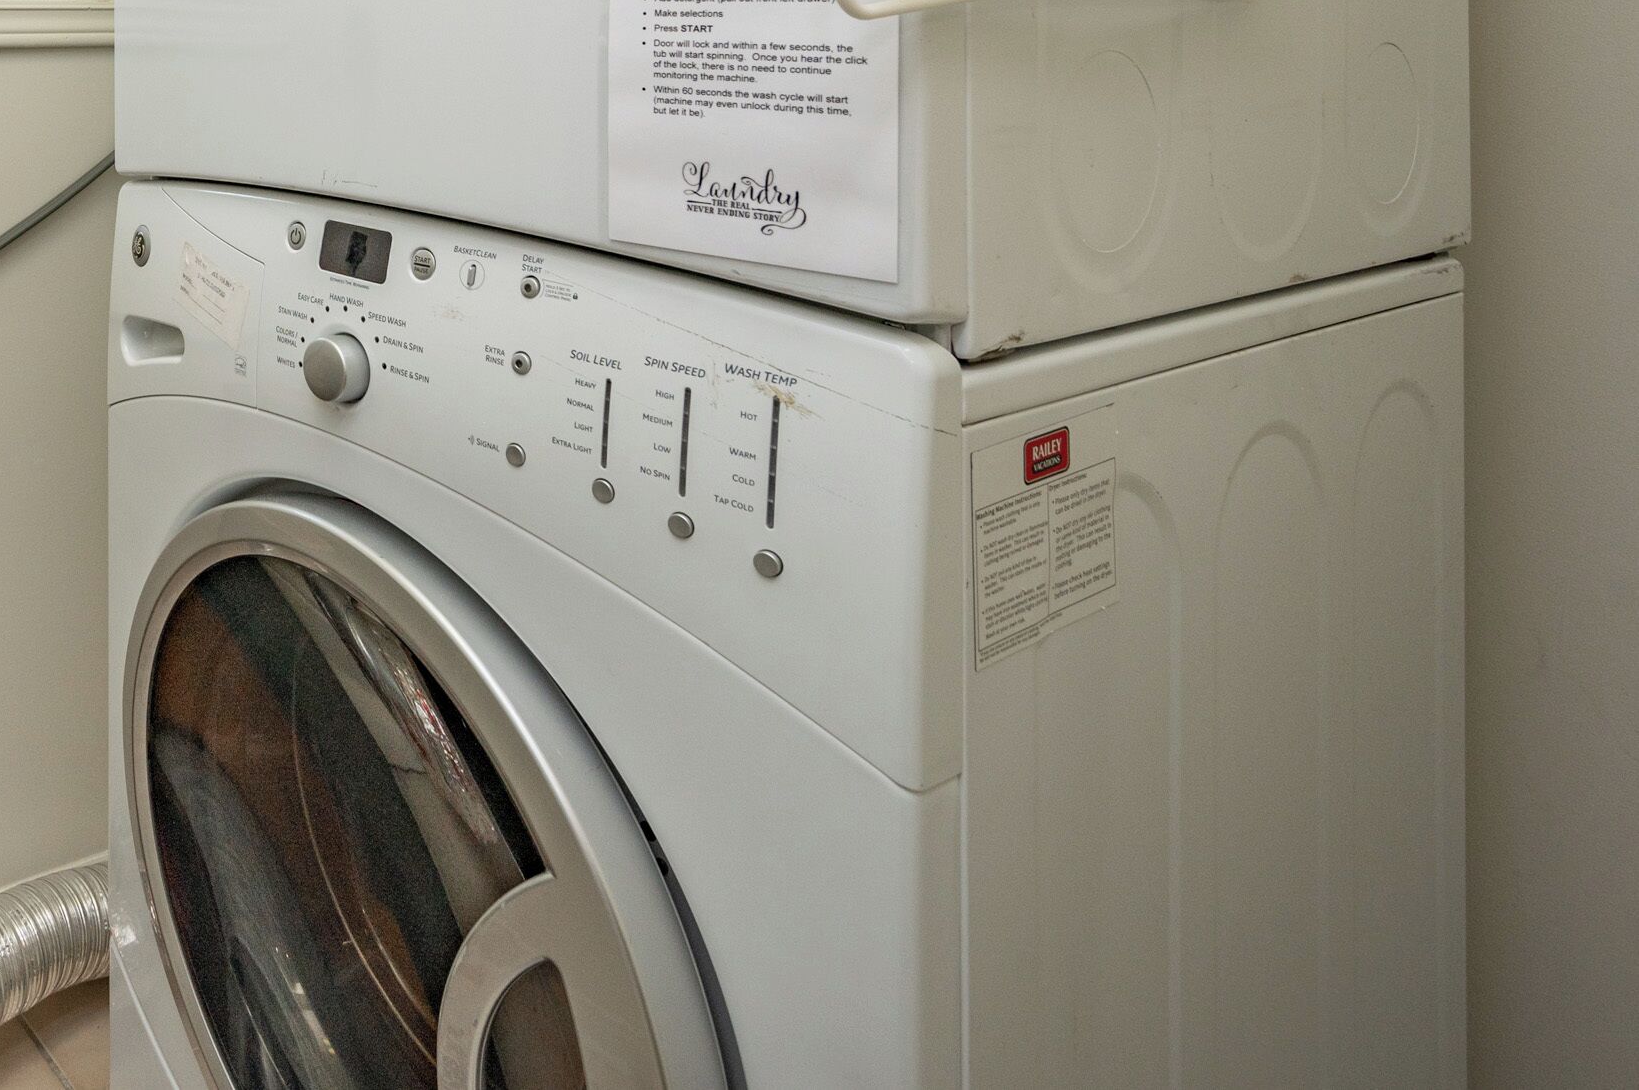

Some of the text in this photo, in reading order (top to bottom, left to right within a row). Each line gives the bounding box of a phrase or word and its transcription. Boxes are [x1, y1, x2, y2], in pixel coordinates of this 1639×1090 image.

[654, 8, 723, 18] Make selections
[653, 23, 713, 33] Press START
[682, 161, 806, 235] Laundry
[711, 198, 749, 210] THE REAL
[686, 204, 779, 222] NEVER ENDING STORY
[522, 254, 544, 264] DELAY
[522, 264, 542, 274] START
[330, 293, 364, 307] HAND WASH
[368, 312, 407, 327] SPEED WASH
[383, 336, 402, 347] DRAIN
[408, 343, 424, 353] SPIN
[485, 345, 505, 356] EXTRA
[486, 355, 504, 366] RINSE
[570, 350, 622, 370] SOIL LEVEL
[644, 356, 706, 378] SPIN SPEED
[390, 366, 408, 377] RINSE
[414, 373, 430, 383] SPIN
[725, 363, 797, 387] WASH TEMP
[575, 378, 596, 389] HEAVY
[655, 390, 674, 400] HIGH
[567, 398, 594, 411] NORMAL
[643, 414, 673, 426] MEDIUM
[741, 411, 757, 421] HOT
[574, 422, 593, 433] LIGHT
[476, 438, 499, 452] SIGNAL
[552, 437, 592, 454] EXTRA LIGHT
[653, 443, 671, 454] LOW
[1032, 438, 1061, 461] RAILEY
[729, 448, 756, 460] WARM
[640, 466, 670, 480] NO SPIN
[732, 474, 755, 487] COLD
[714, 495, 754, 512] TAP COLD
